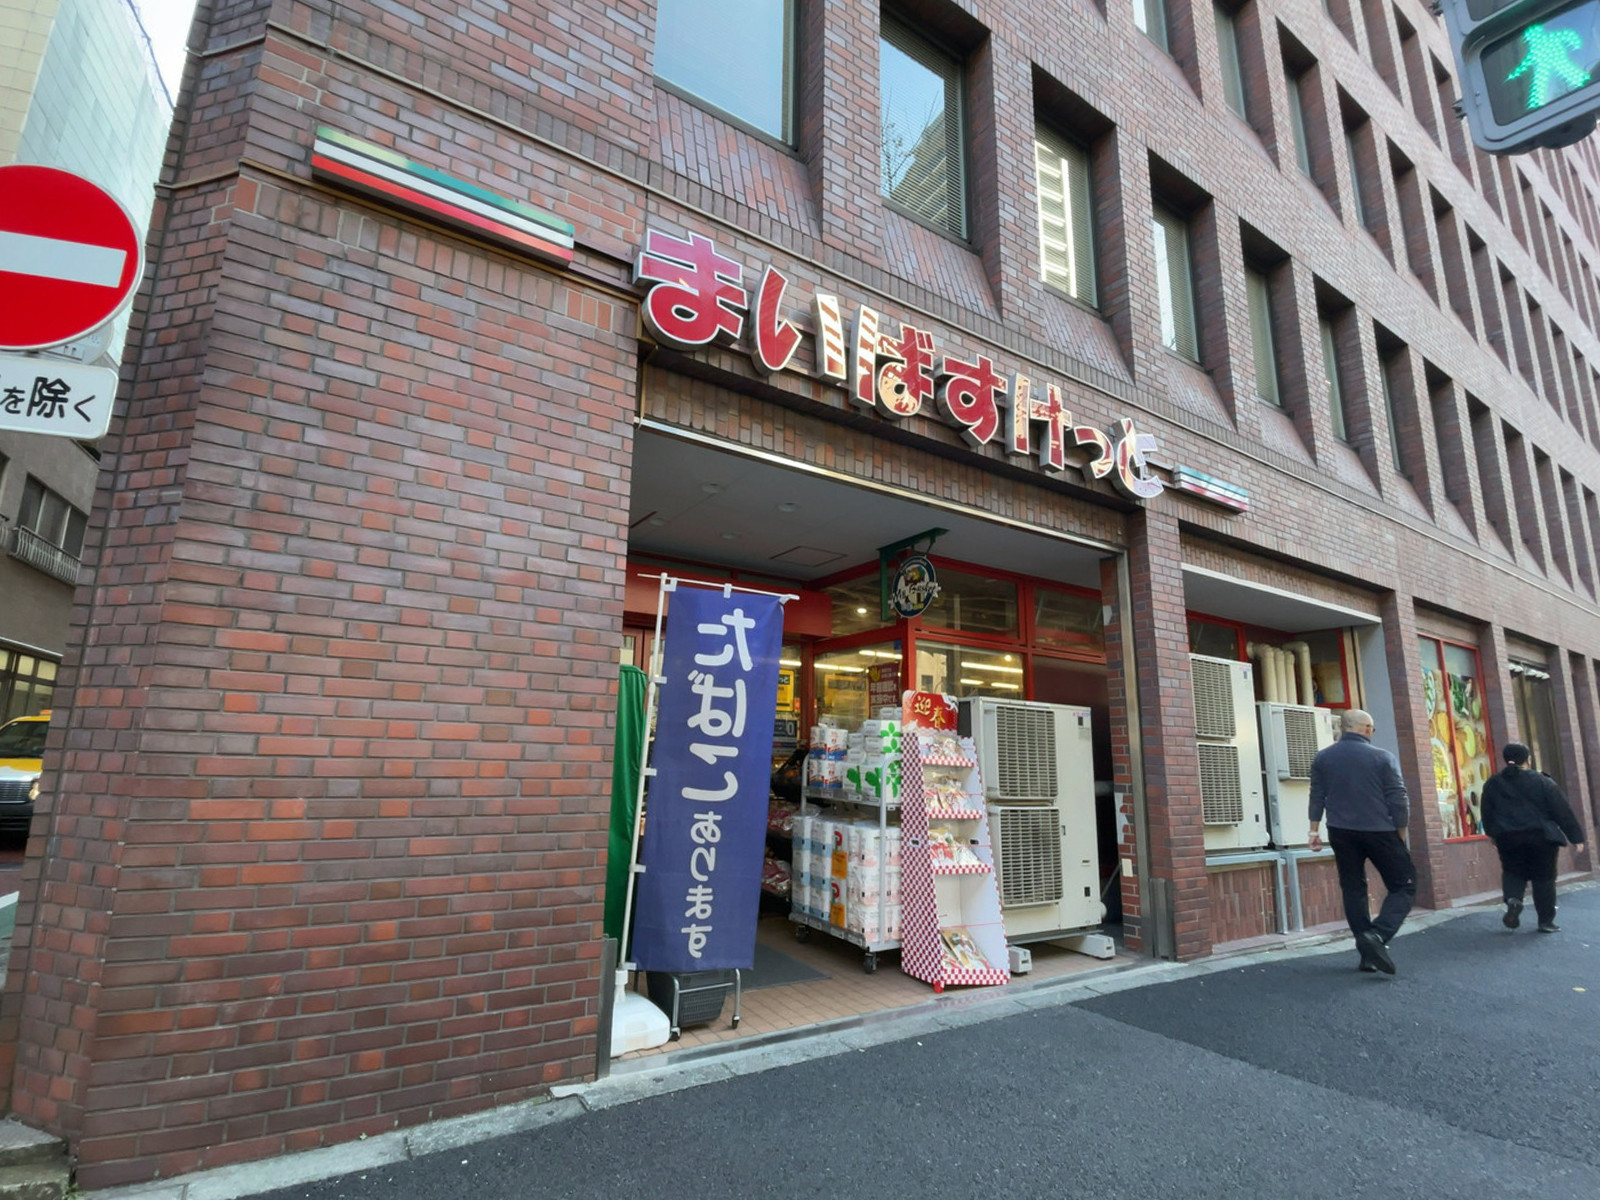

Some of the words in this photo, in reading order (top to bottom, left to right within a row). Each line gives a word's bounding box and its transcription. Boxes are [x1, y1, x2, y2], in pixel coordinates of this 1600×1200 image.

[634, 228, 1164, 499] まいばすけっと
[0, 376, 96, 423] を除く
[914, 695, 947, 730] 迎春
